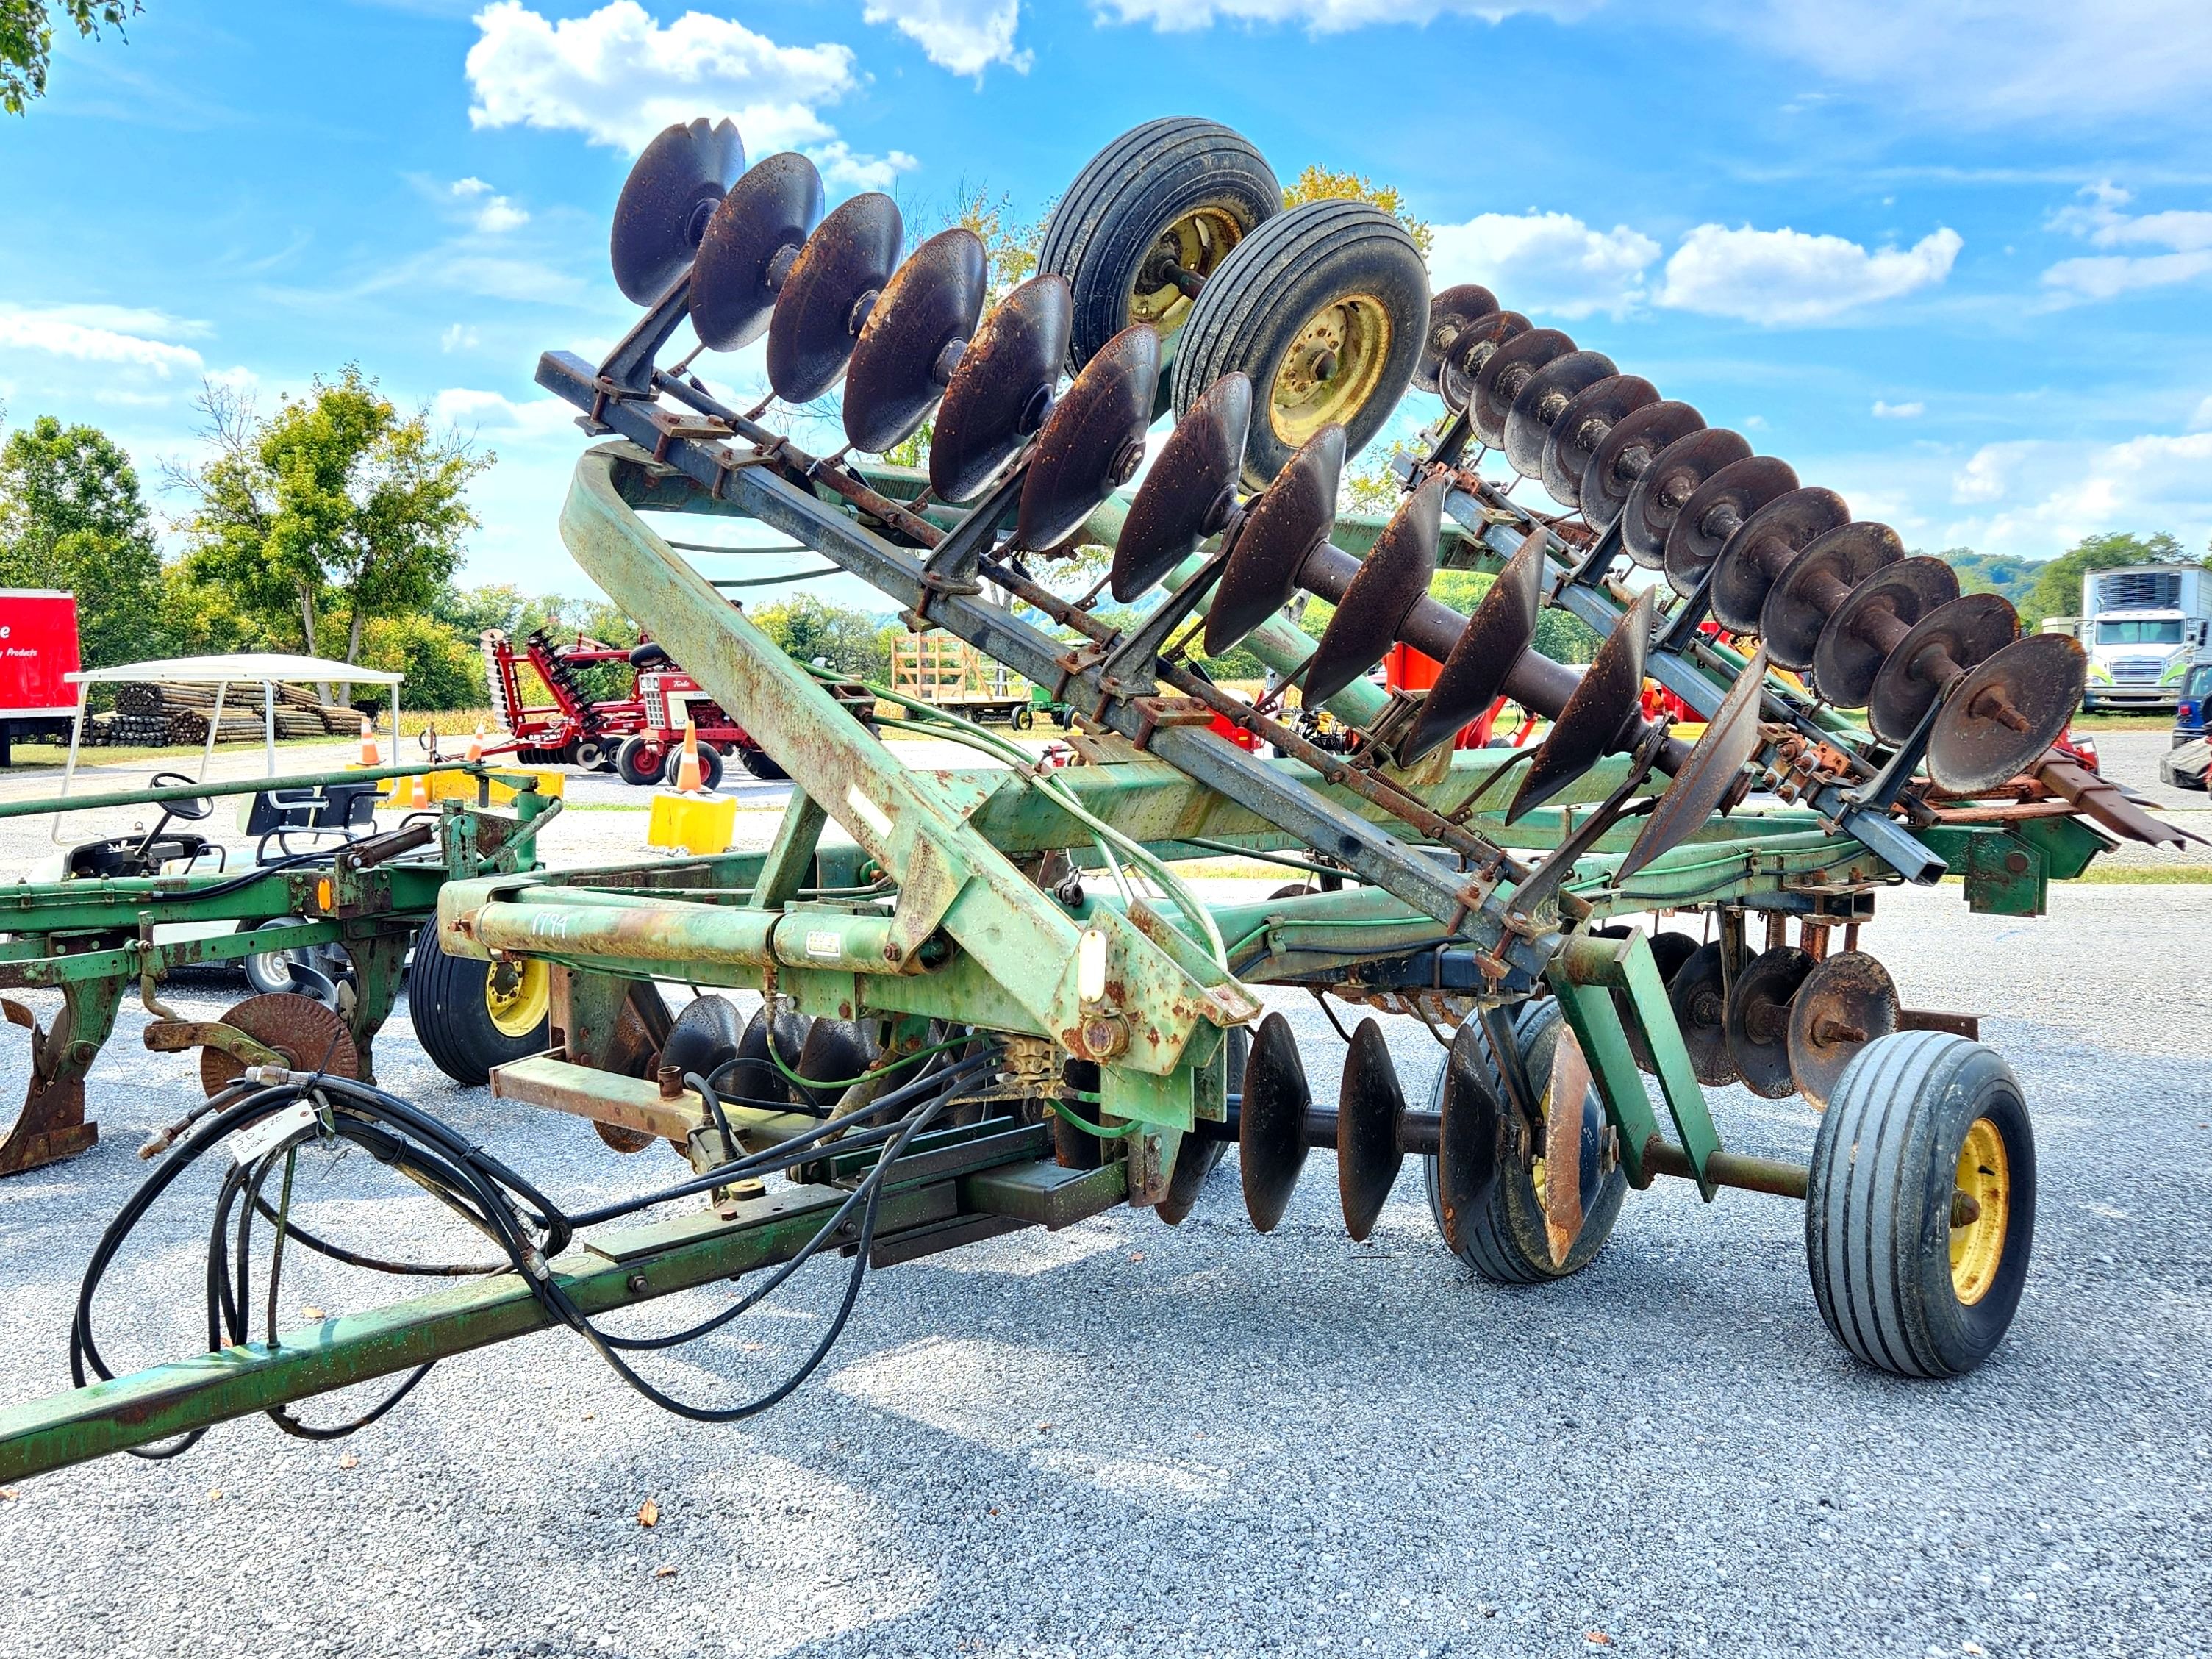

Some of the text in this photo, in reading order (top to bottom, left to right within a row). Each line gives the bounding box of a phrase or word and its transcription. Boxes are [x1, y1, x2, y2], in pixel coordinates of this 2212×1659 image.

[7, 647, 37, 656] Products
[235, 1115, 283, 1147] JD 220
